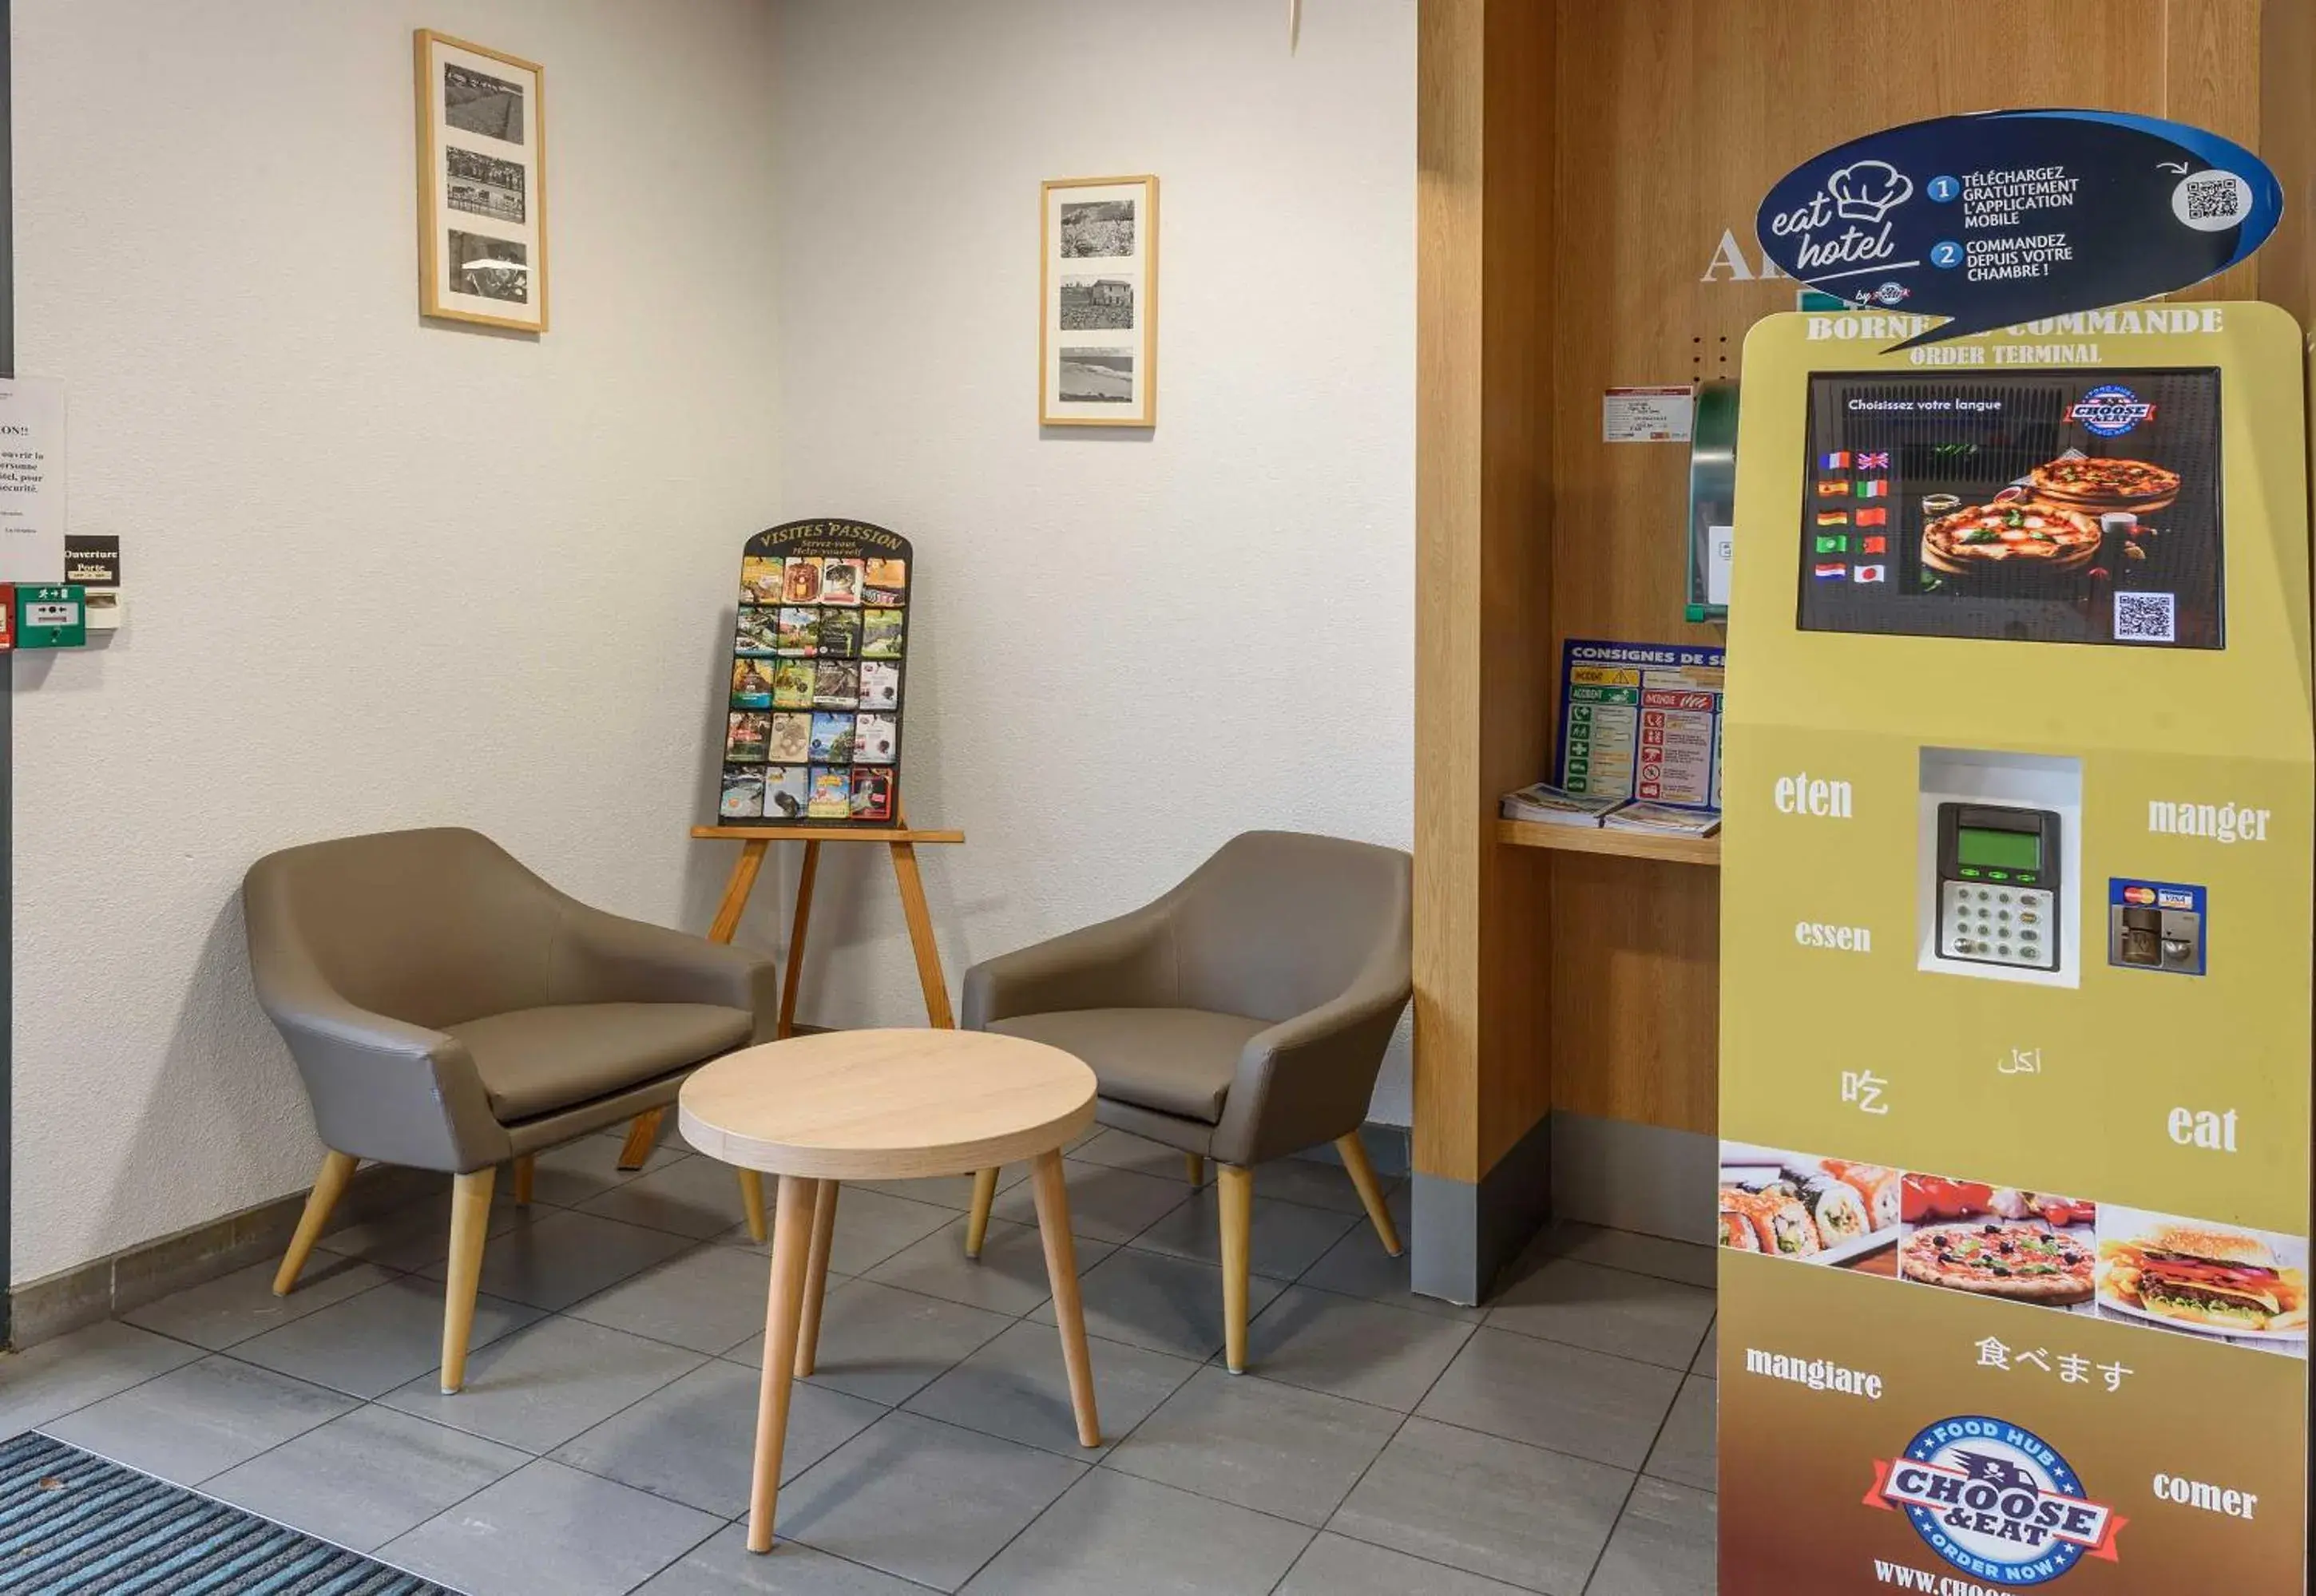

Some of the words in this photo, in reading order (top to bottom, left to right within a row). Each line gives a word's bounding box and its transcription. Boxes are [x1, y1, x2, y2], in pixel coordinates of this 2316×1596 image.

[1937, 180, 1949, 198] 1
[1962, 165, 2065, 188] TÉLÉCHARGEZ
[1963, 178, 2080, 202] GRATUITEMENT
[1771, 191, 1832, 236] eat
[1964, 193, 2073, 215] L'APPLICATION
[1965, 212, 2021, 229] MOBILE
[1797, 221, 1895, 270] hotel
[1940, 246, 1956, 264] 2
[1966, 234, 2067, 255] COMMANDEZ
[1967, 251, 2020, 268] DEPUIS
[2023, 247, 2073, 264] VOTRE
[1968, 263, 2041, 283] CHAMBRE
[1806, 315, 1931, 341] BORNE
[1910, 345, 1985, 366] ORDER
[1993, 343, 2103, 364] TERMINAL
[1848, 399, 1913, 410] Choisissez
[1917, 400, 1951, 410] votre
[1955, 398, 2002, 411] langue
[2075, 406, 2147, 415] CHOOSE
[761, 524, 824, 547] VISITES
[828, 522, 902, 551] PASSION
[1571, 647, 1676, 663] CONSIGNES
[1680, 653, 1703, 665] DE
[1775, 771, 1853, 818] eten
[2147, 800, 2271, 843] manger
[1795, 921, 1871, 952] essen
[1841, 1070, 1889, 1115] 吃
[2167, 1106, 2238, 1151] eat
[1746, 1348, 1883, 1400] mangiare
[1974, 1336, 2134, 1392] 食べます
[1933, 1420, 1998, 1443] FOOD
[2006, 1429, 2055, 1467] HUB
[1895, 1468, 2097, 1536] CHOOSE
[2153, 1472, 2258, 1519] comer
[1943, 1507, 2048, 1547] &EAT
[1931, 1533, 1998, 1579] ORDER
[2005, 1558, 2055, 1582] NOW
